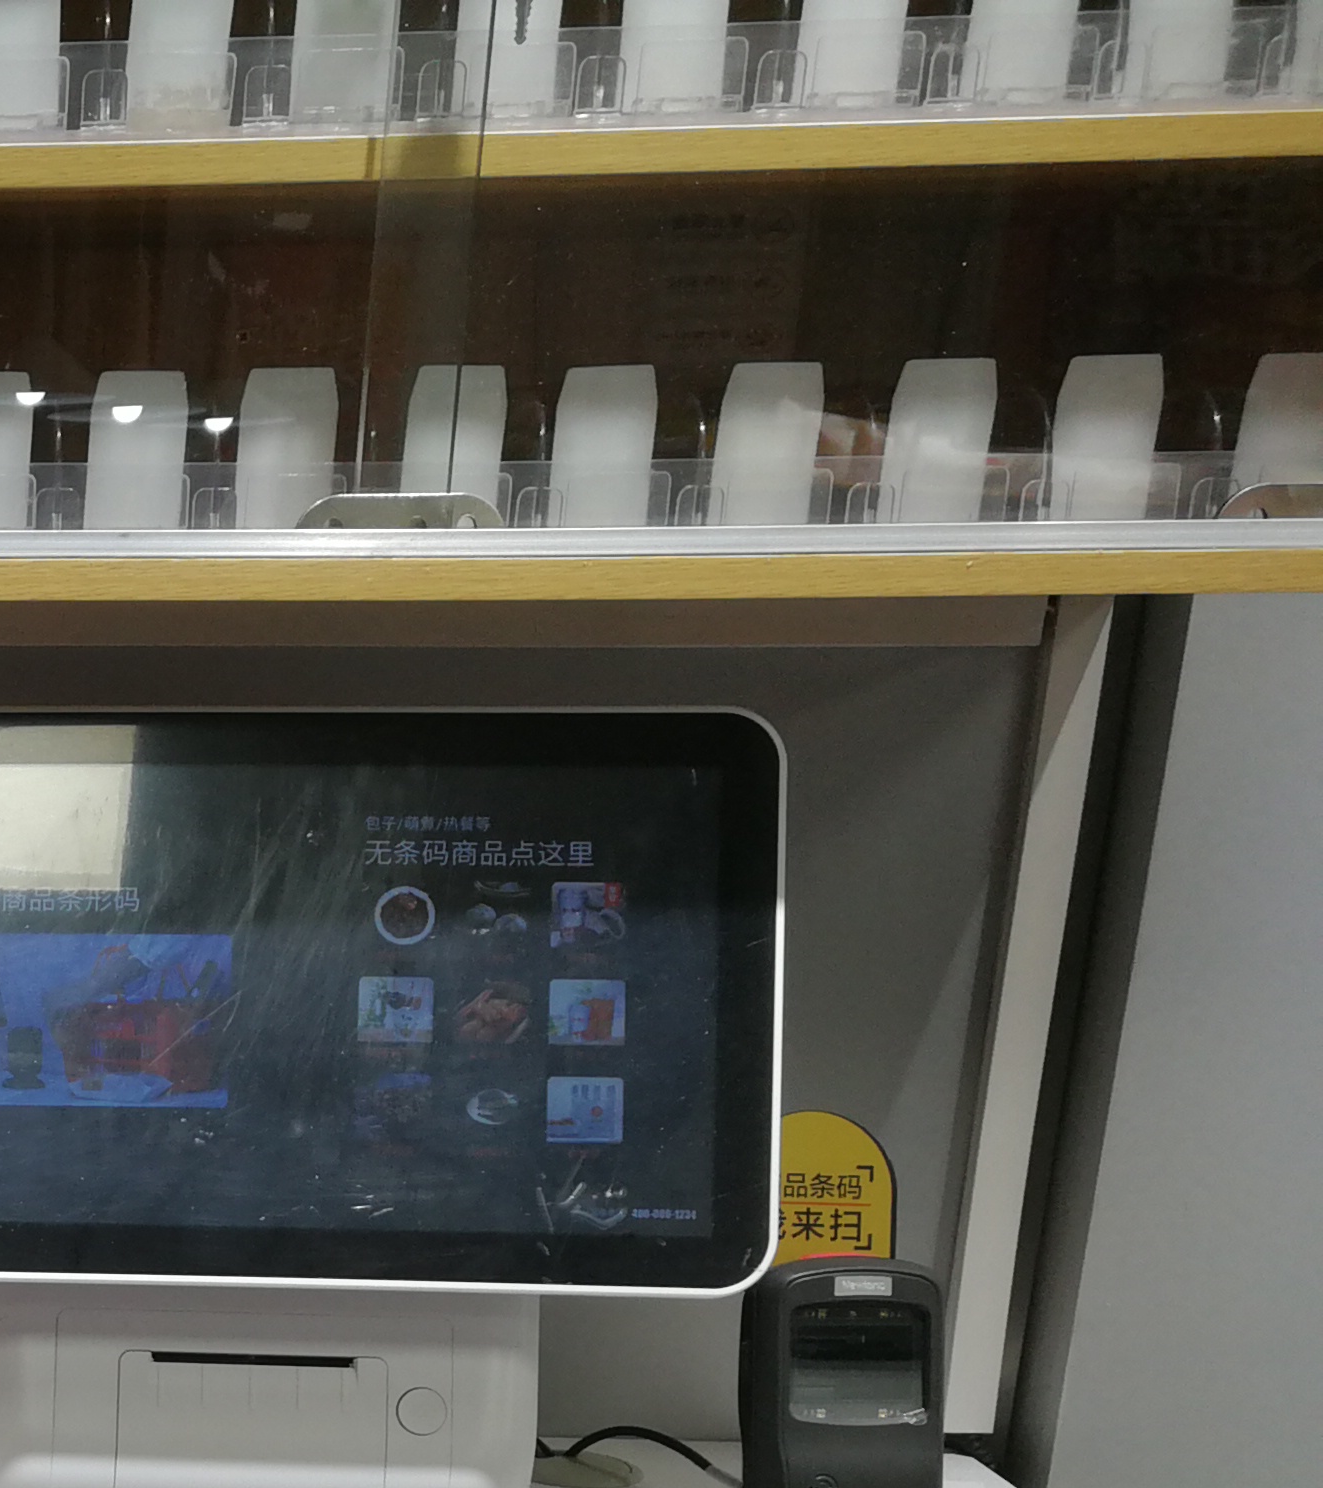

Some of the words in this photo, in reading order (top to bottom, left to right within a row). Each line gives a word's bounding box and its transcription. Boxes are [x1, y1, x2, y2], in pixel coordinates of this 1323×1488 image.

[364, 839, 595, 868] 无条码商品点这里
